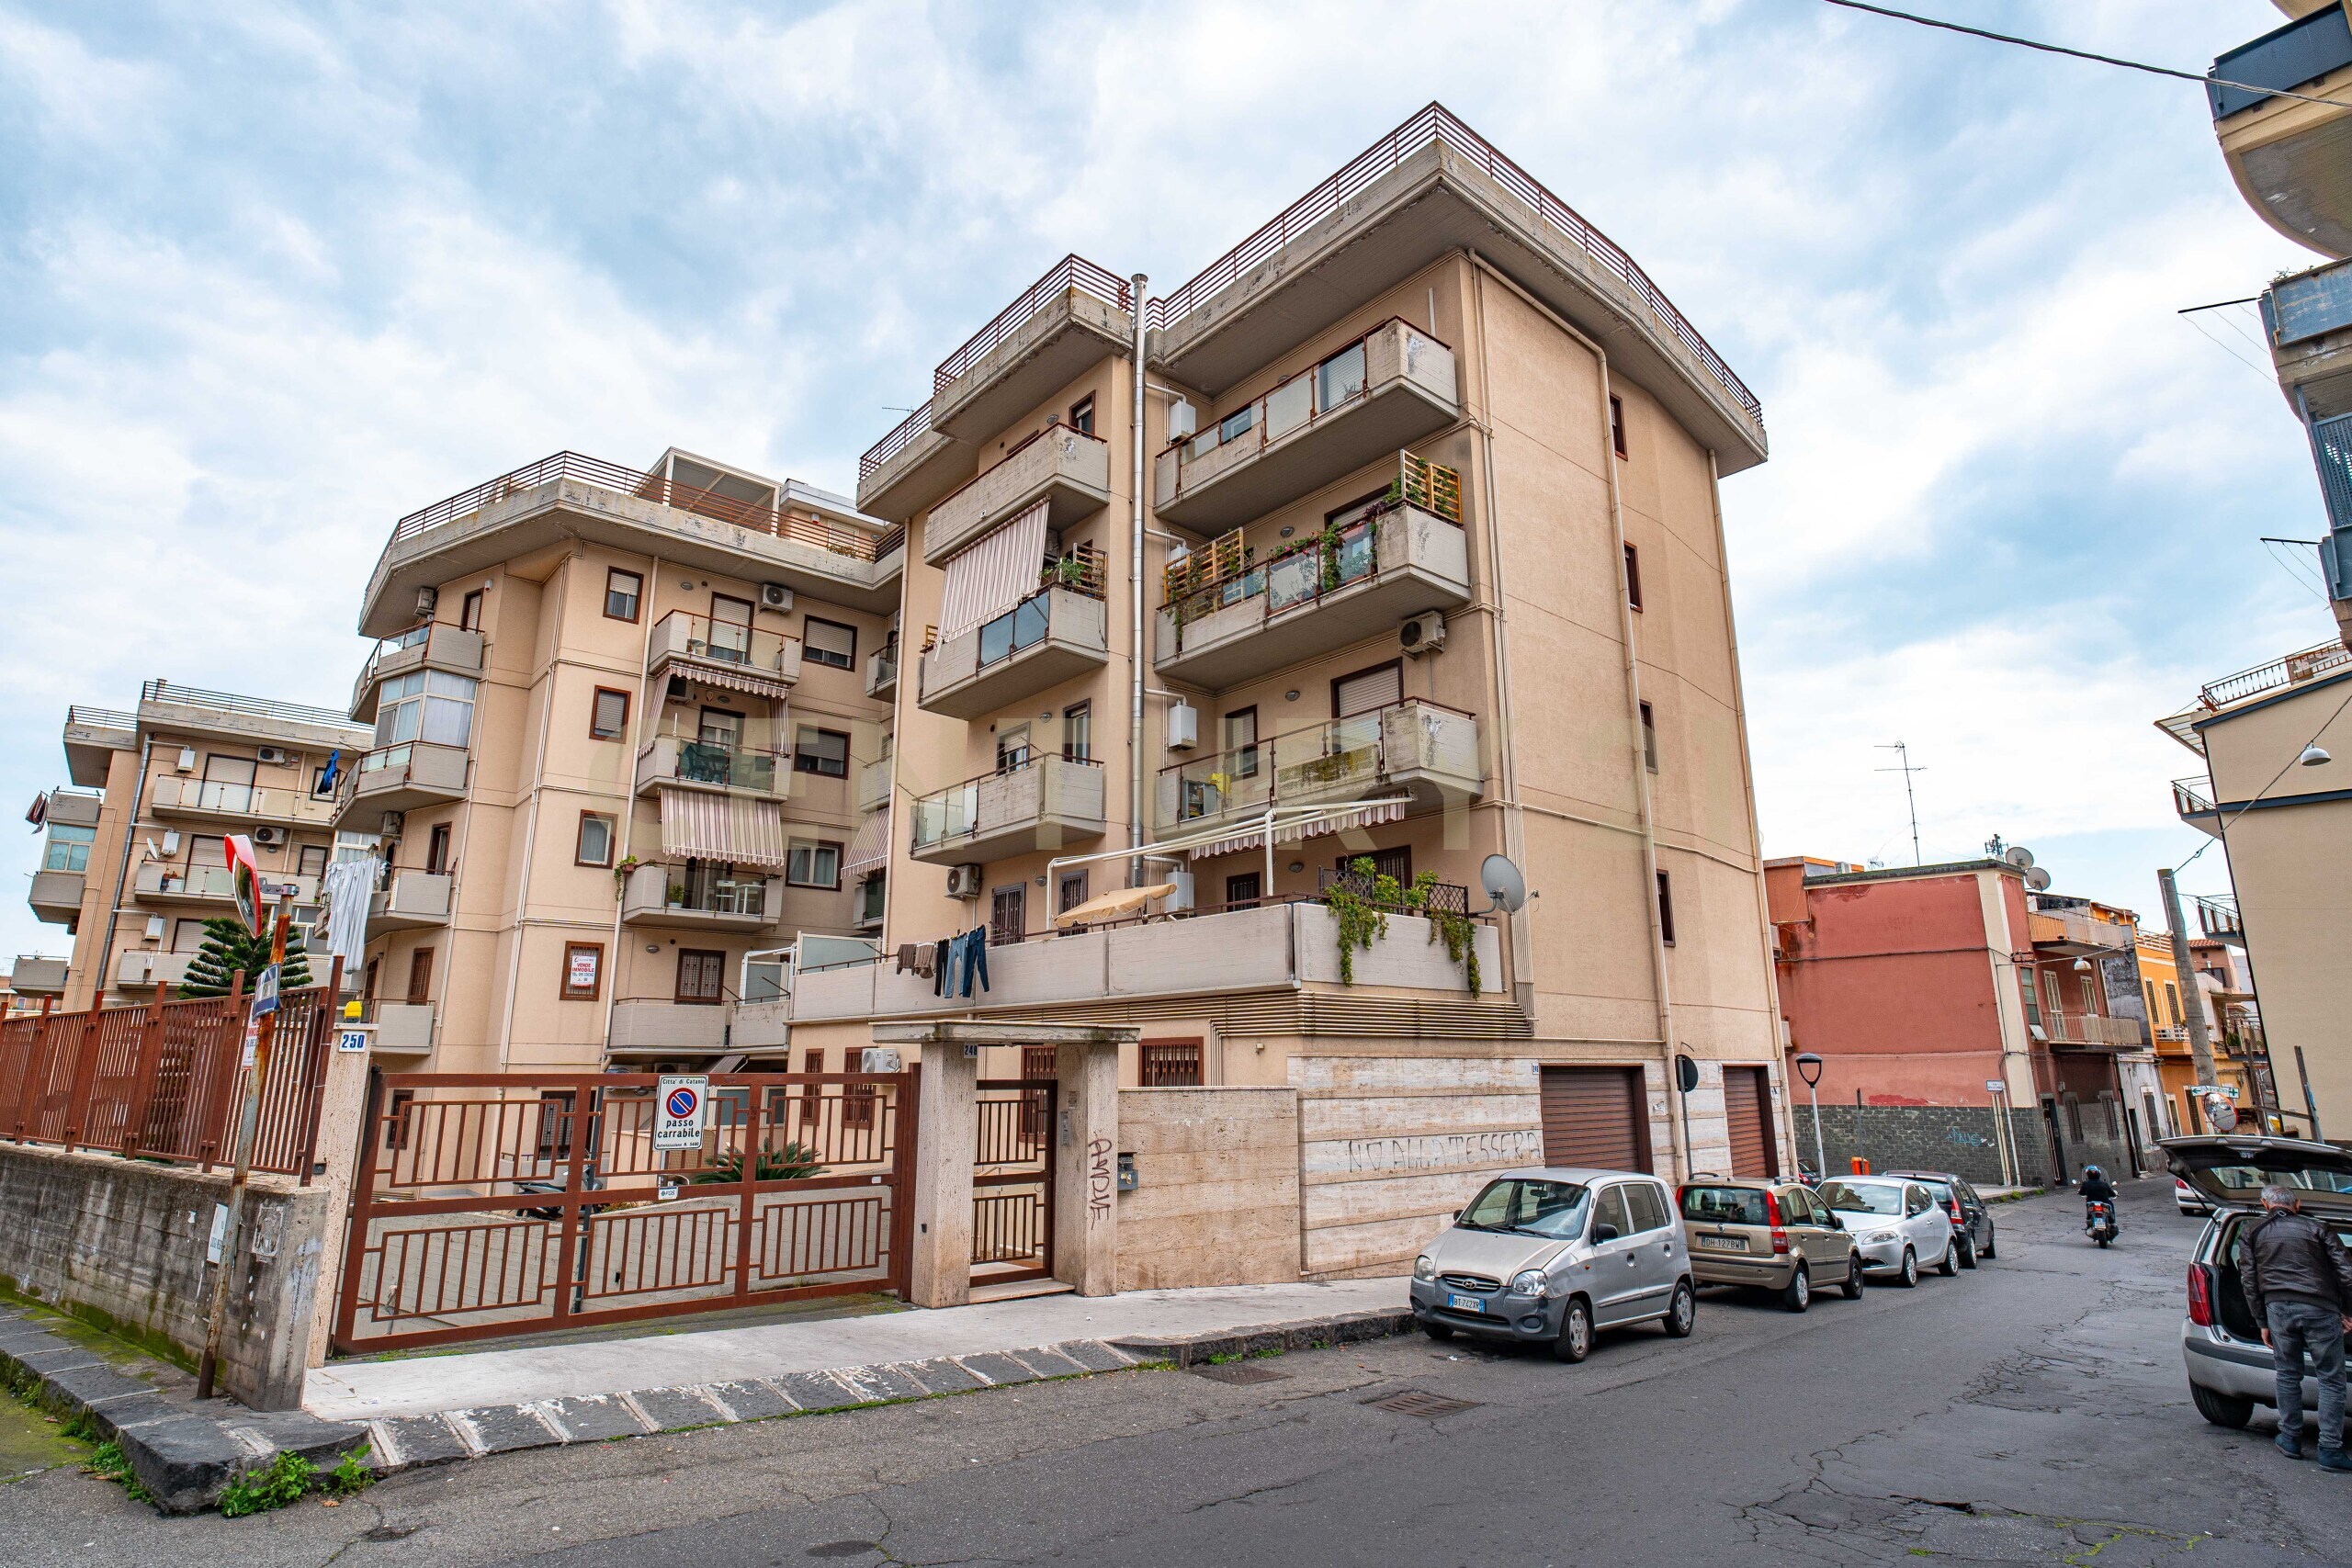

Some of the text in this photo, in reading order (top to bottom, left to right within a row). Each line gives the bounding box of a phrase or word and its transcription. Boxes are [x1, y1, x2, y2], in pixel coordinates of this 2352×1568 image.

[341, 1033, 365, 1048] 250
[965, 1044, 978, 1055] 248
[666, 1120, 694, 1129] passo
[657, 1128, 700, 1138] carrabile
[1349, 1140, 1383, 1173] NO
[1449, 1132, 1542, 1164] TESSERA
